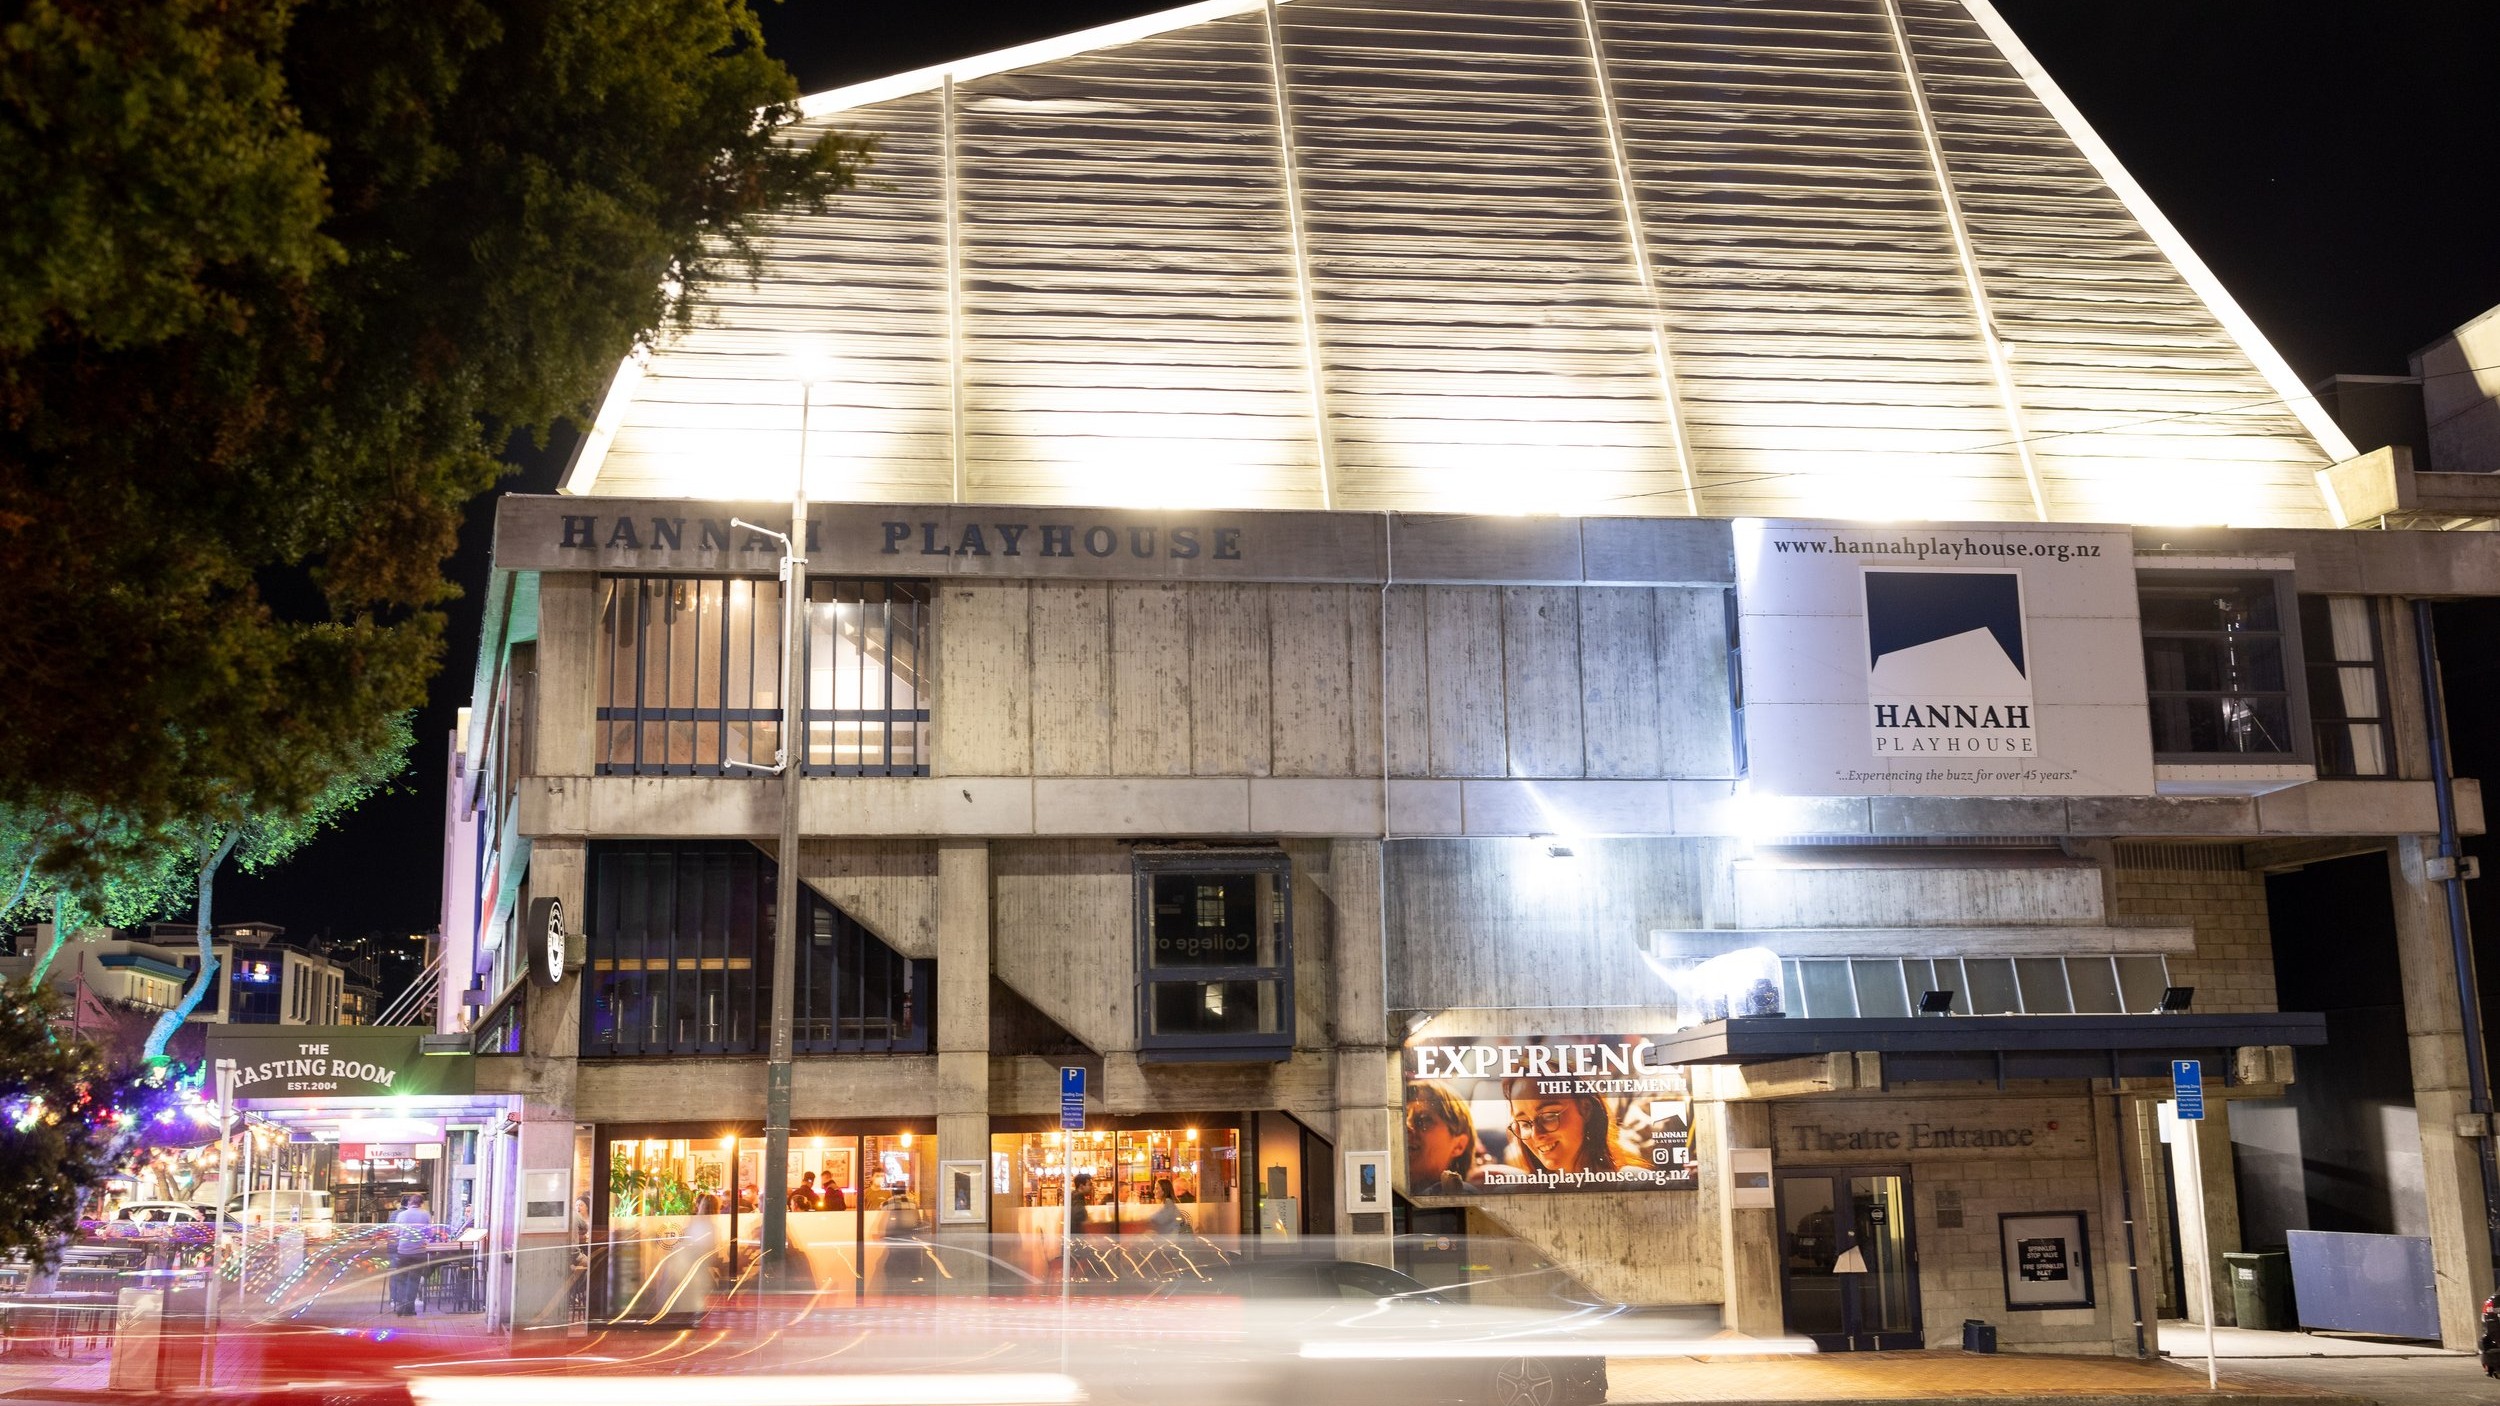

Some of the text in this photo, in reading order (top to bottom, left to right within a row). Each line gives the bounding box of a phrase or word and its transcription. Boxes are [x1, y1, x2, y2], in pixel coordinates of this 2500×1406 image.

[881, 521, 1243, 560] PLAYHOUSE
[1774, 536, 2101, 562] www.hannahplayhouse.org.nz
[1874, 704, 2031, 729] HANNAH
[1876, 737, 2032, 752] PLAYHOUSE
[1925, 769, 1944, 782] the
[1947, 768, 1974, 782] buzz
[1974, 769, 1993, 784] for
[1996, 771, 2021, 782] over
[2023, 770, 2037, 781] 45
[299, 1044, 330, 1055] THE
[1414, 1042, 1684, 1079] EXPERIENC
[2182, 1062, 2191, 1074] P
[232, 1058, 396, 1088] TASTING ROOM
[1069, 1069, 1078, 1081] P
[1537, 1081, 1571, 1095] THE
[1652, 1131, 1687, 1139] HANNAH
[1792, 1123, 2034, 1151] Theatre Entrance
[1484, 1167, 1690, 1188] hannahplayhouse.org.nz
